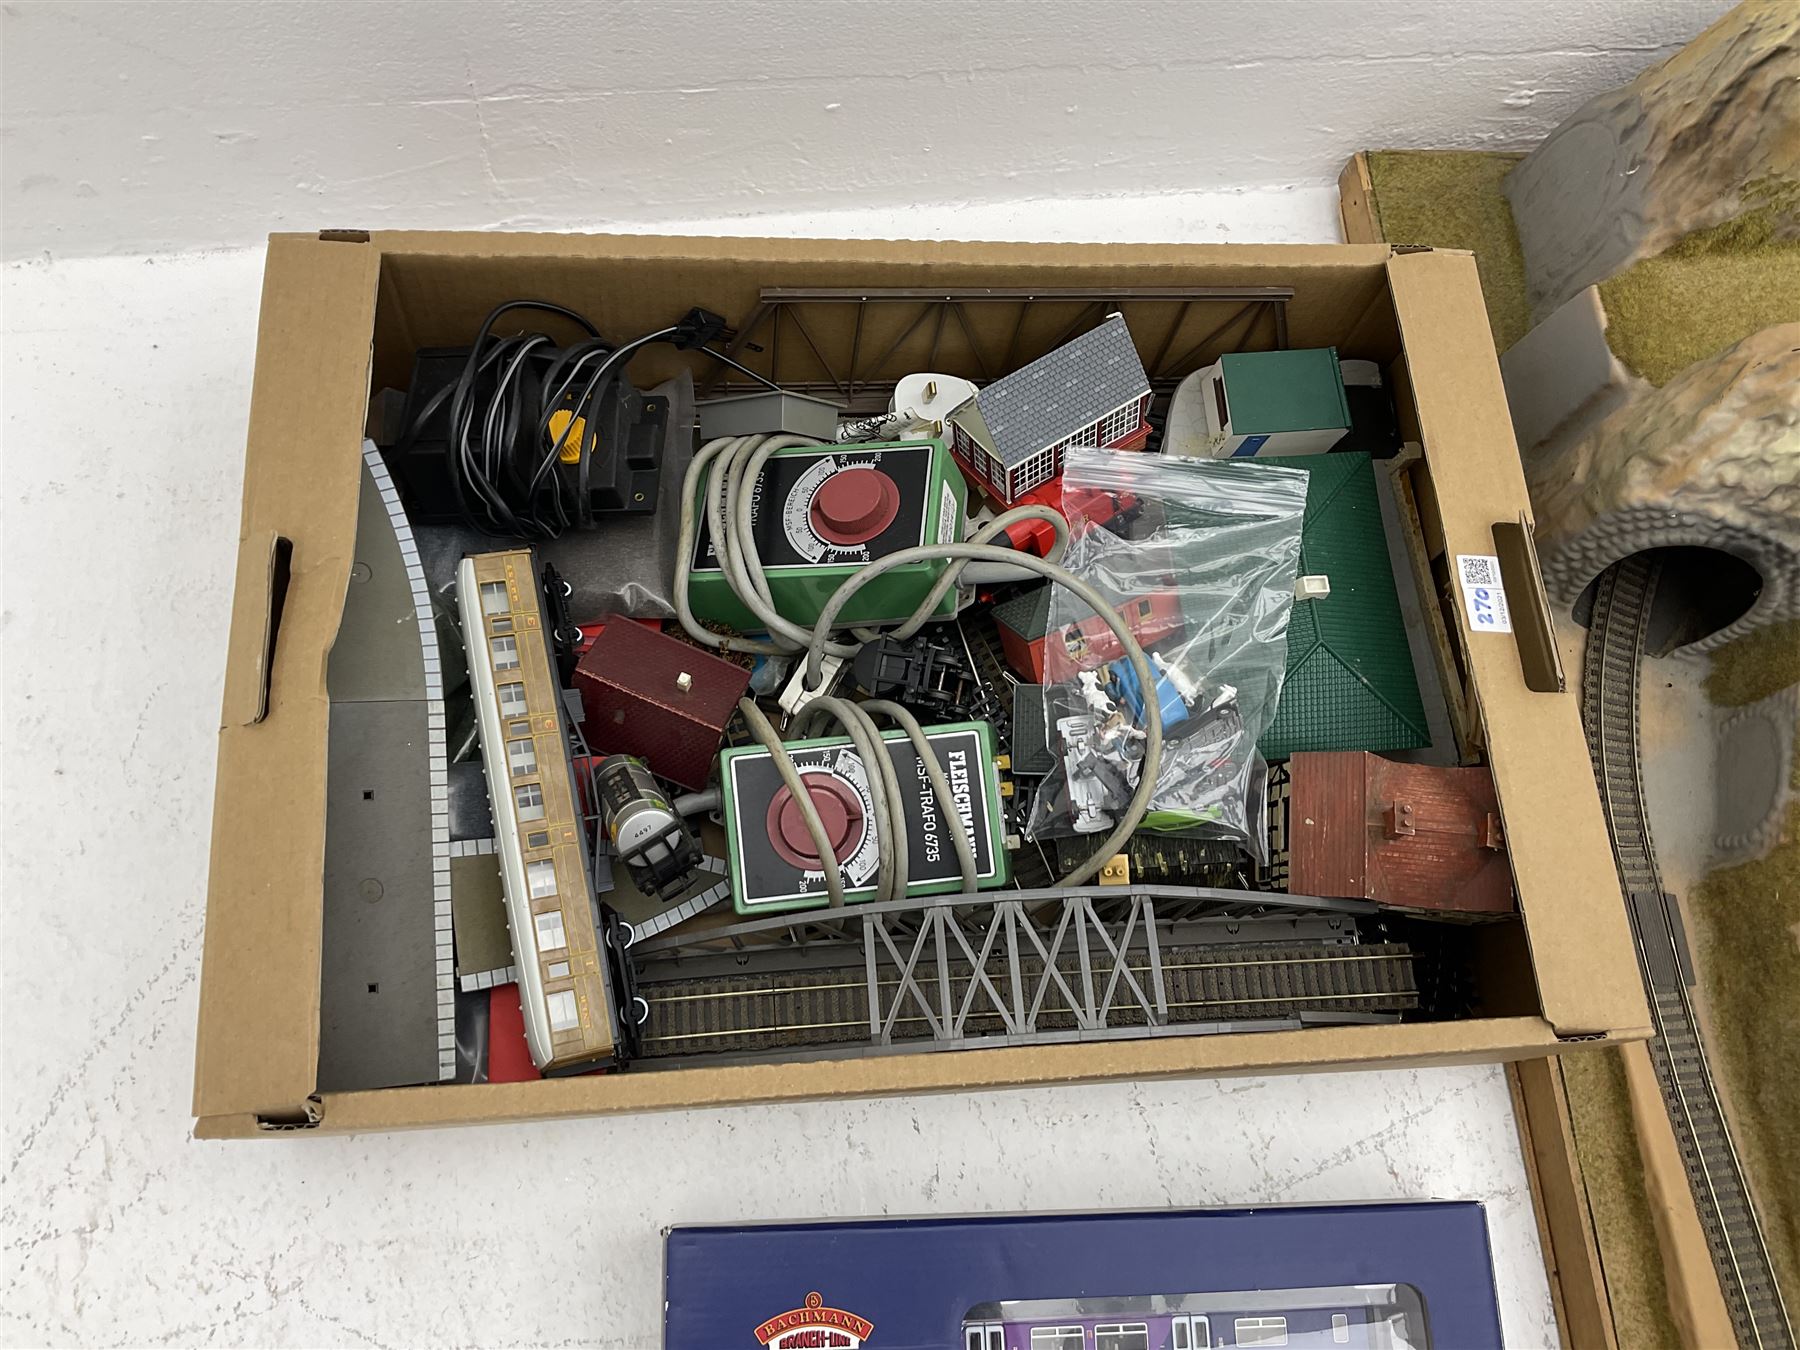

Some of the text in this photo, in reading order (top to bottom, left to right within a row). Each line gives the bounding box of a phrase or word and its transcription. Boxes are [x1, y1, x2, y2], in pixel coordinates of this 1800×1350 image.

[785, 487, 800, 532] MSF-BEREICH
[1472, 587, 1494, 625] 270
[1496, 592, 1508, 625] 03/12/2021
[948, 750, 977, 859] FLEISCHMA
[634, 824, 653, 838] 4497
[924, 833, 940, 862] 6735
[798, 880, 808, 893] 200
[764, 1310, 866, 1337] BACHMANN
